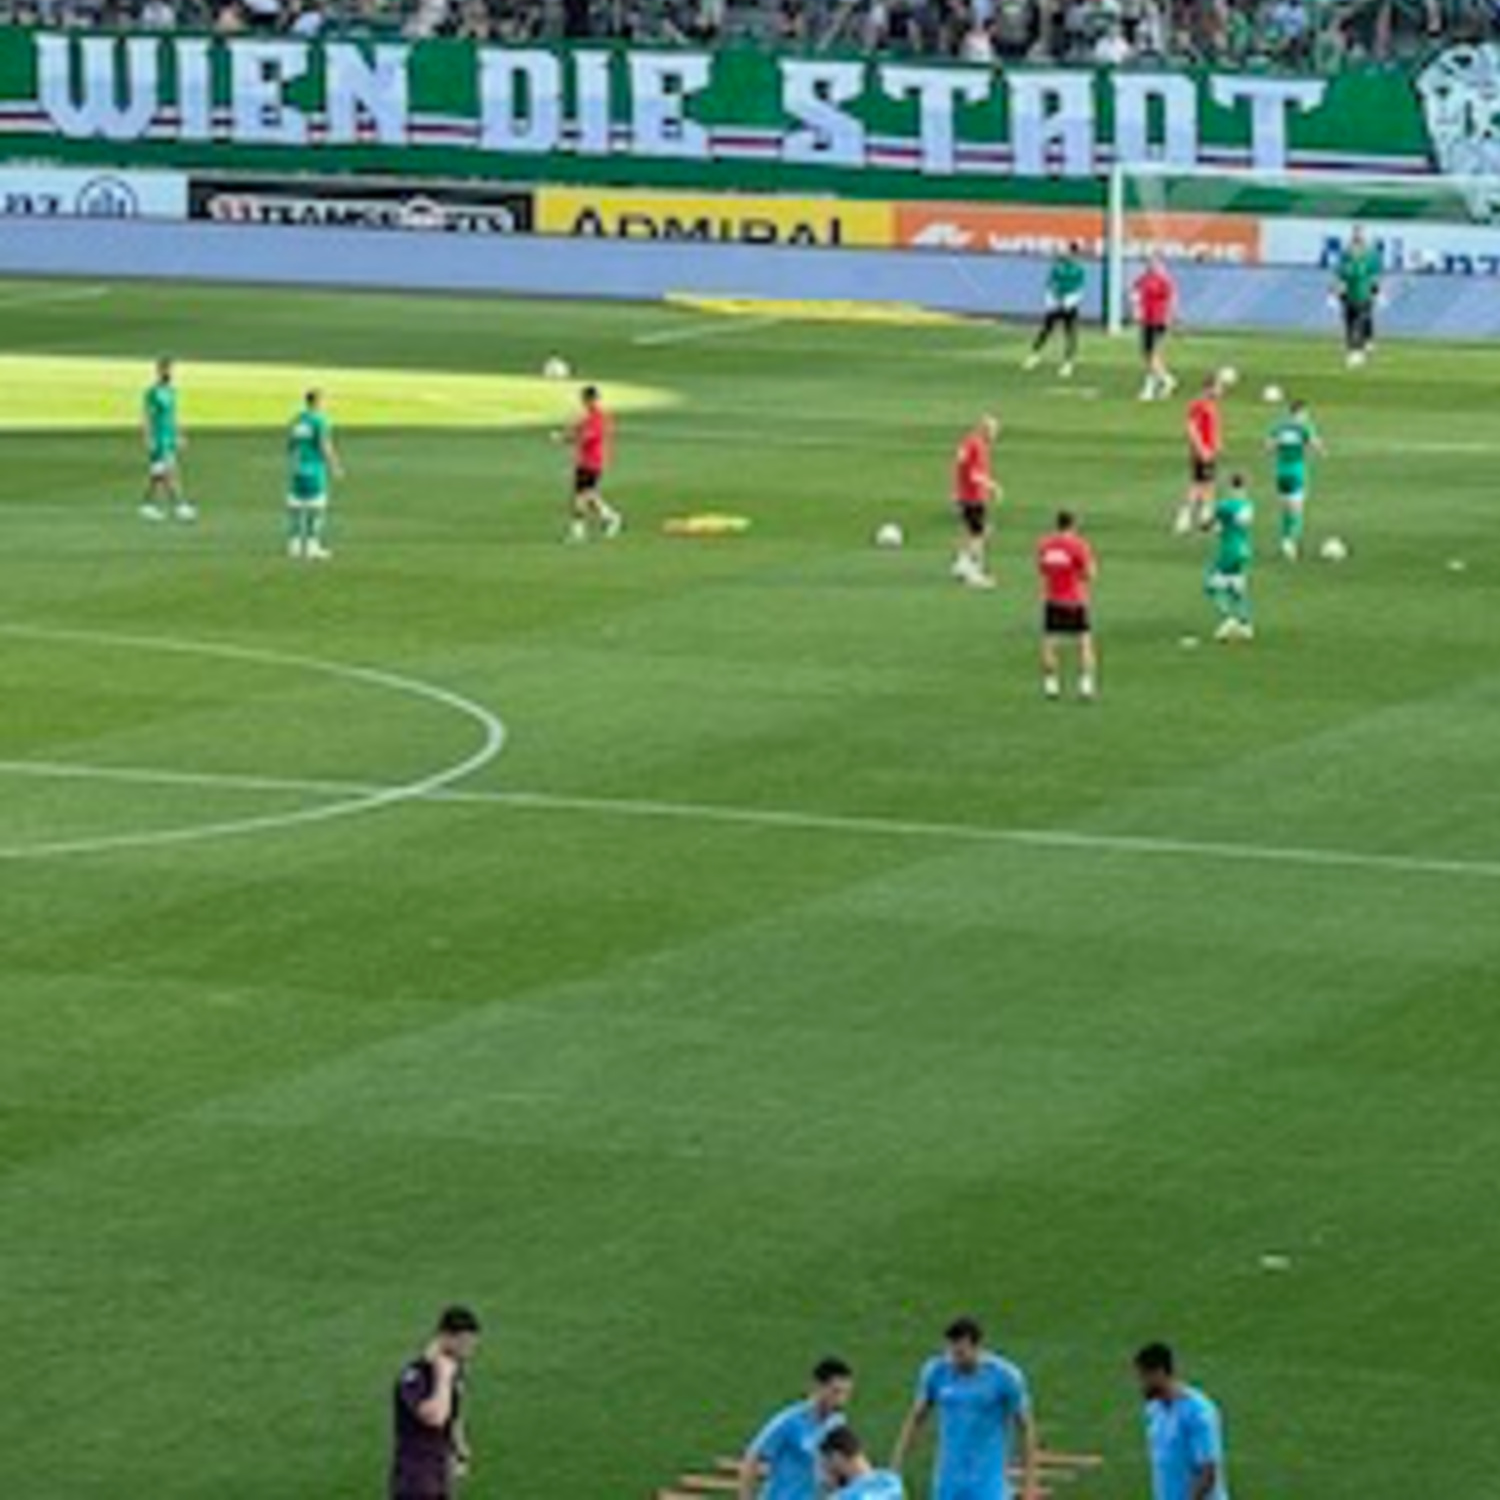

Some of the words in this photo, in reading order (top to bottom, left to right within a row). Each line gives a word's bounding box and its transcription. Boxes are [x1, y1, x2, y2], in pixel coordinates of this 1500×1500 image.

[37, 33, 412, 145] WIEN
[478, 47, 714, 156] DIE
[778, 57, 1328, 176] STADT
